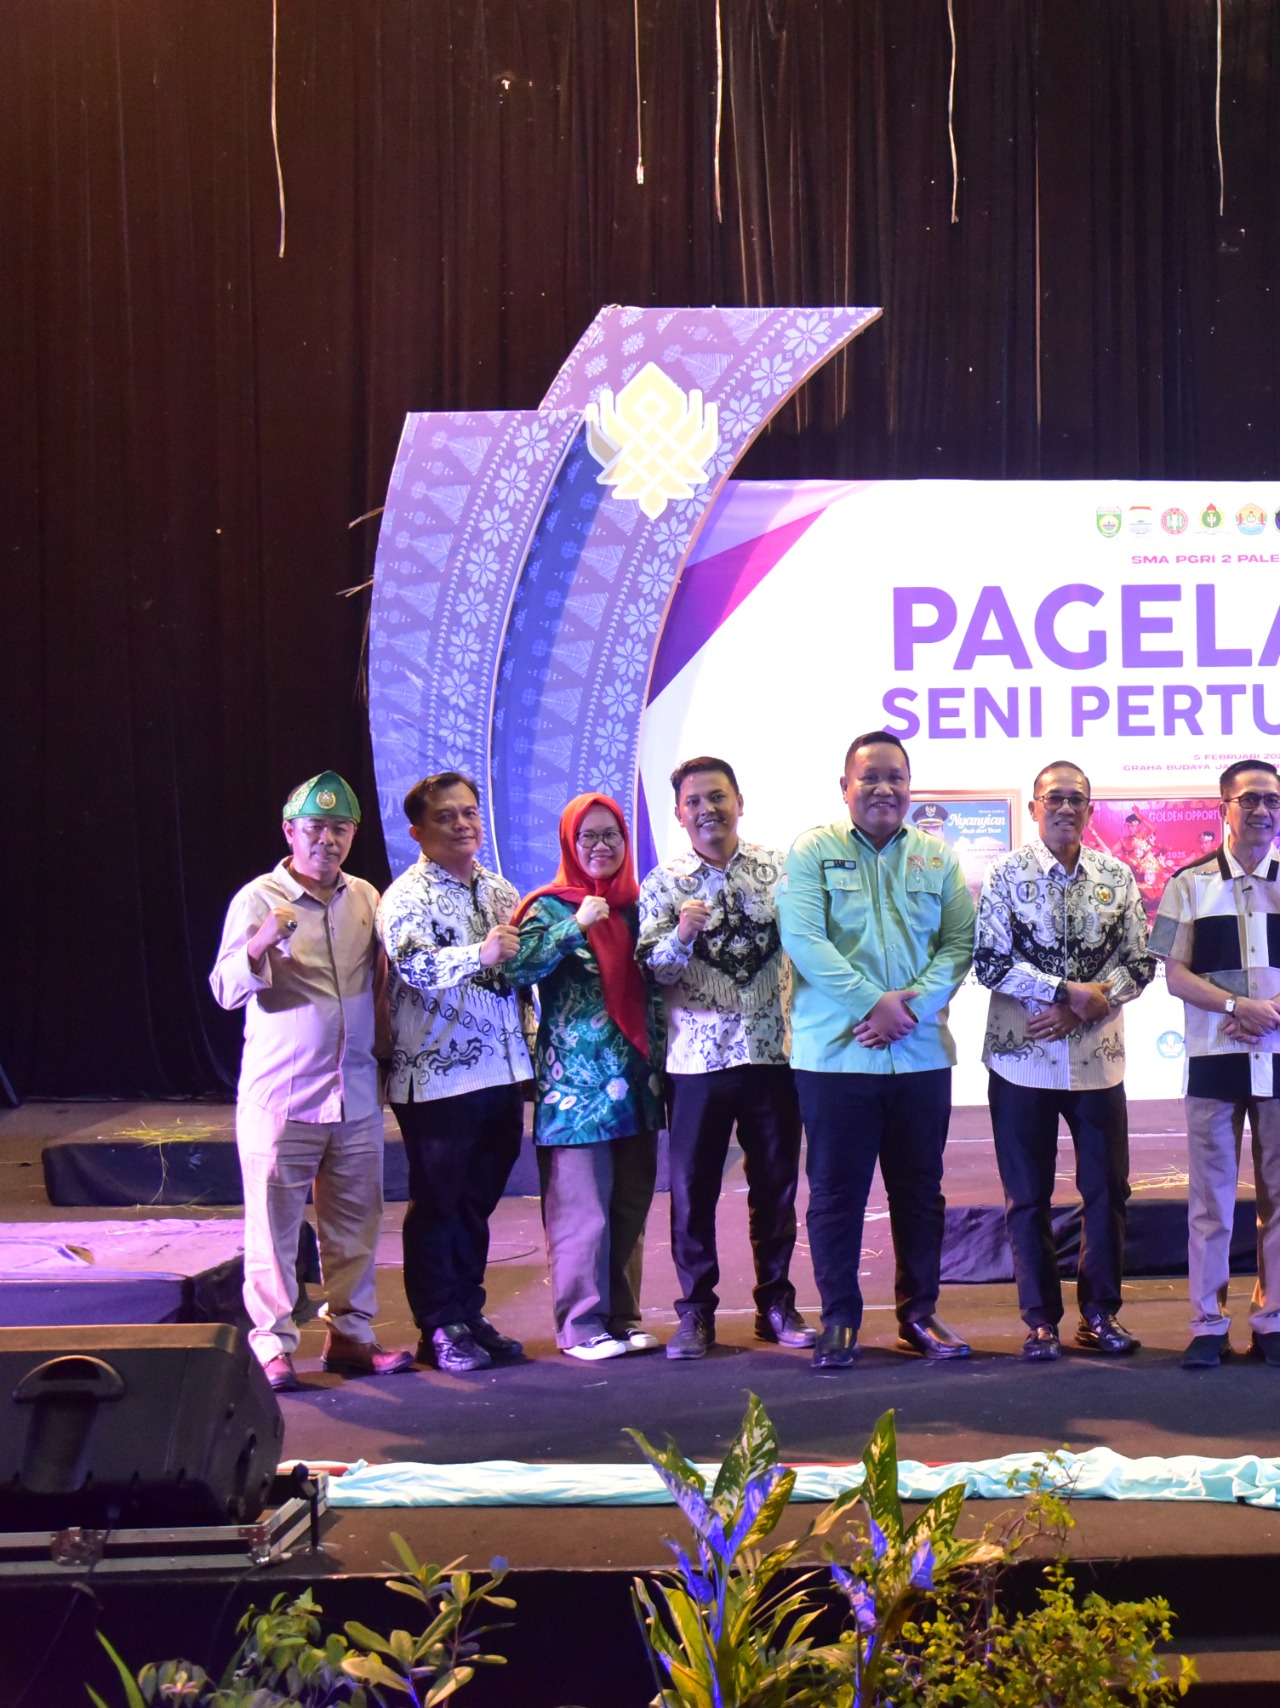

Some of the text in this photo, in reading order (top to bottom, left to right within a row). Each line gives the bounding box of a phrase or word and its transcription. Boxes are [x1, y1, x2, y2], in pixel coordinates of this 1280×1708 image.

[1131, 555, 1169, 565] SMA
[1175, 555, 1216, 564] PGRI
[1221, 554, 1232, 564] 2
[882, 685, 1043, 740] SENI
[1204, 753, 1260, 761] FEBRUARI
[1122, 764, 1163, 772] GRAHA
[1166, 763, 1211, 771] BUDAYA
[947, 813, 1006, 830] Nyanyian
[1149, 811, 1184, 822] GOLDEN
[1167, 851, 1187, 859] 2025
